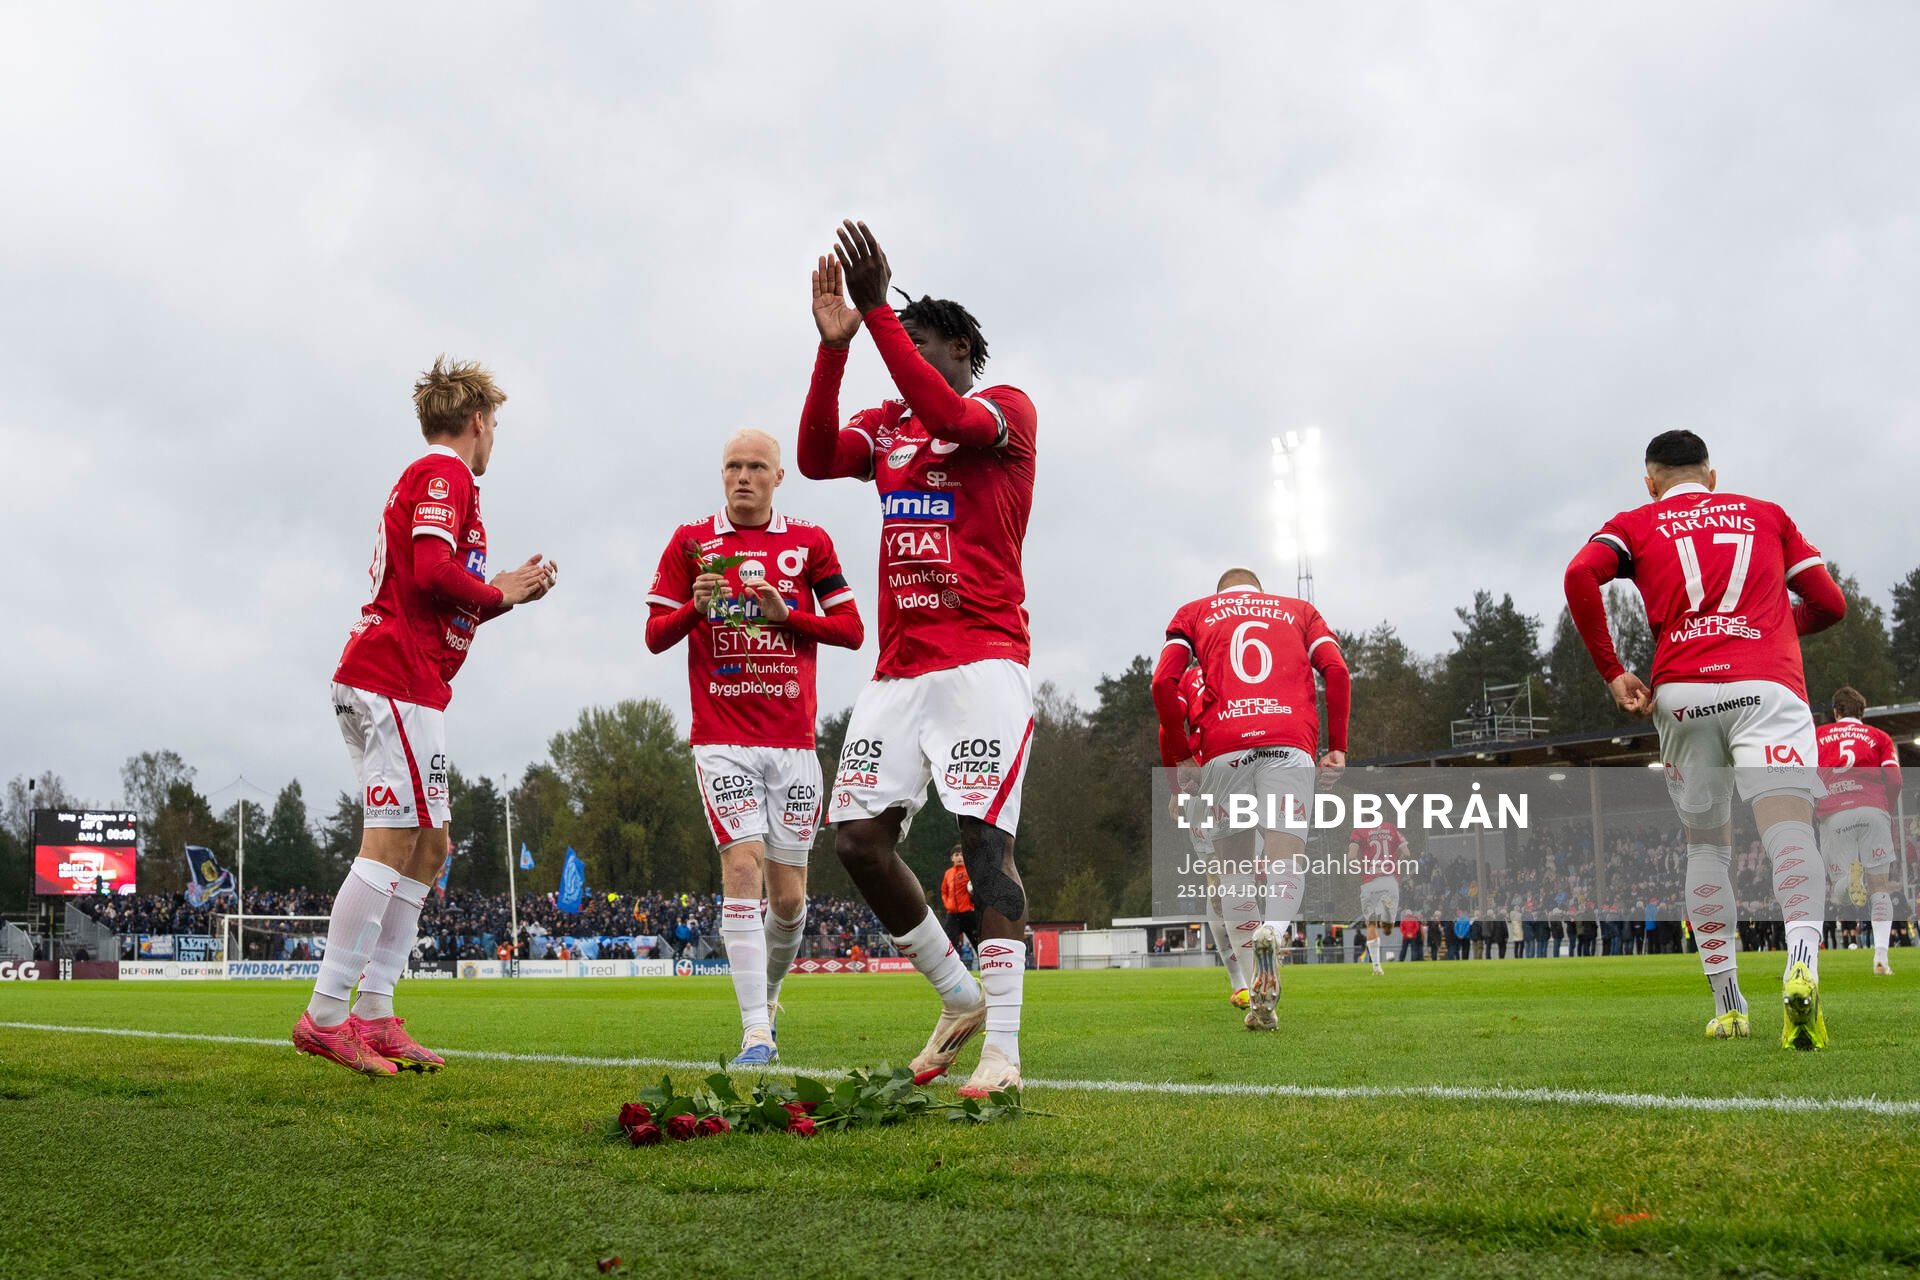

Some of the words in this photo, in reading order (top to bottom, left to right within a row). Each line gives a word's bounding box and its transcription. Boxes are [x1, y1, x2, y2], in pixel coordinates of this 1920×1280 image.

[418, 506, 453, 520] UNIBET
[1657, 502, 1747, 520] skogsmat
[1656, 515, 1756, 539] TARANIS
[739, 569, 765, 577] MHE
[888, 569, 959, 588] Munkfors
[1675, 533, 1754, 613] 17
[895, 592, 940, 610] ialog
[1210, 597, 1280, 609] skogsmat
[1204, 606, 1296, 627] SUNDGREN
[1684, 615, 1747, 630] NORDIC
[1670, 624, 1762, 643] WELLNESS
[1229, 620, 1273, 684] 6
[745, 662, 799, 674] Munkfors
[1699, 663, 1731, 673] umbro
[1227, 698, 1279, 709] NORDIC
[1687, 695, 1761, 719] VÄSTANHEDE
[1218, 705, 1292, 721] WELLNESS
[1241, 730, 1266, 738] umbro
[951, 739, 1001, 760] CEOS
[1765, 744, 1805, 766] ICA
[1832, 739, 1856, 774] 5
[712, 775, 753, 792] CEOS
[944, 773, 1001, 787] D-LAB
[366, 786, 400, 807] ICA
[366, 807, 401, 817] Degerfors
[786, 801, 815, 812] FRITZ
[729, 817, 741, 831] 10
[120, 967, 164, 976] DEFORM
[180, 967, 224, 976] DEFORM
[591, 963, 616, 976] real
[641, 963, 666, 976] real
